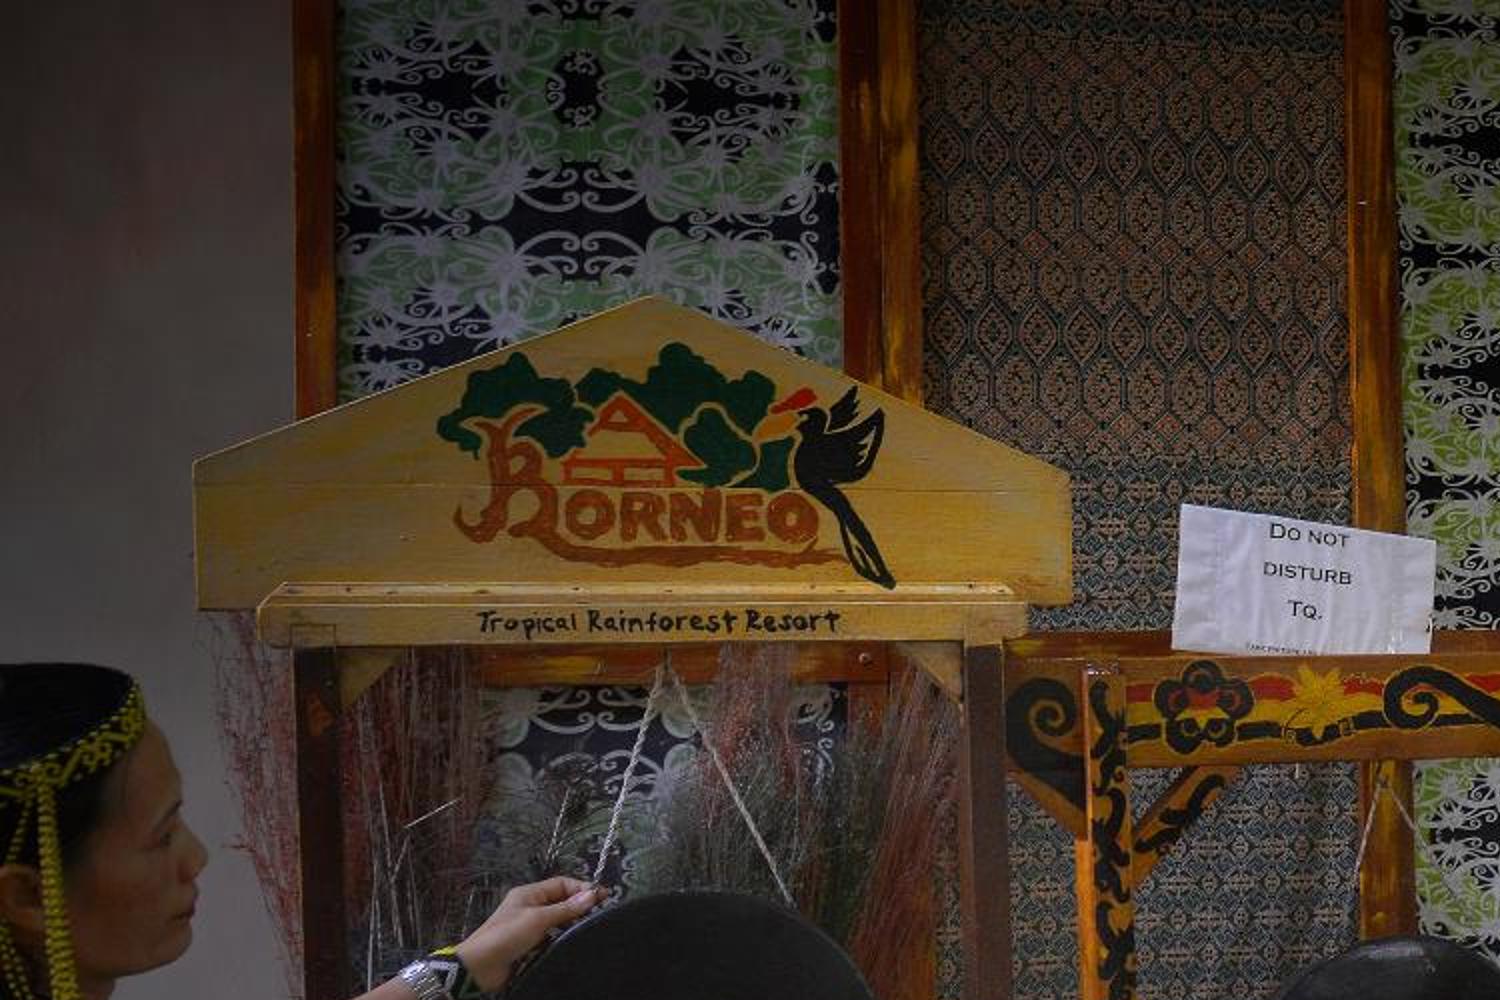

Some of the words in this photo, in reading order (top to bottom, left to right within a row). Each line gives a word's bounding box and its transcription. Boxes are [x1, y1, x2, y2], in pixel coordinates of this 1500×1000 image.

[453, 404, 822, 566] BORNEO
[1269, 522, 1301, 541] DO
[1308, 530, 1350, 549] NOT
[1263, 561, 1352, 585] DISTURB
[1287, 600, 1323, 621] TQ.
[476, 611, 577, 640] Tropical
[588, 609, 738, 634] Rainforest
[745, 609, 841, 634] Resort
